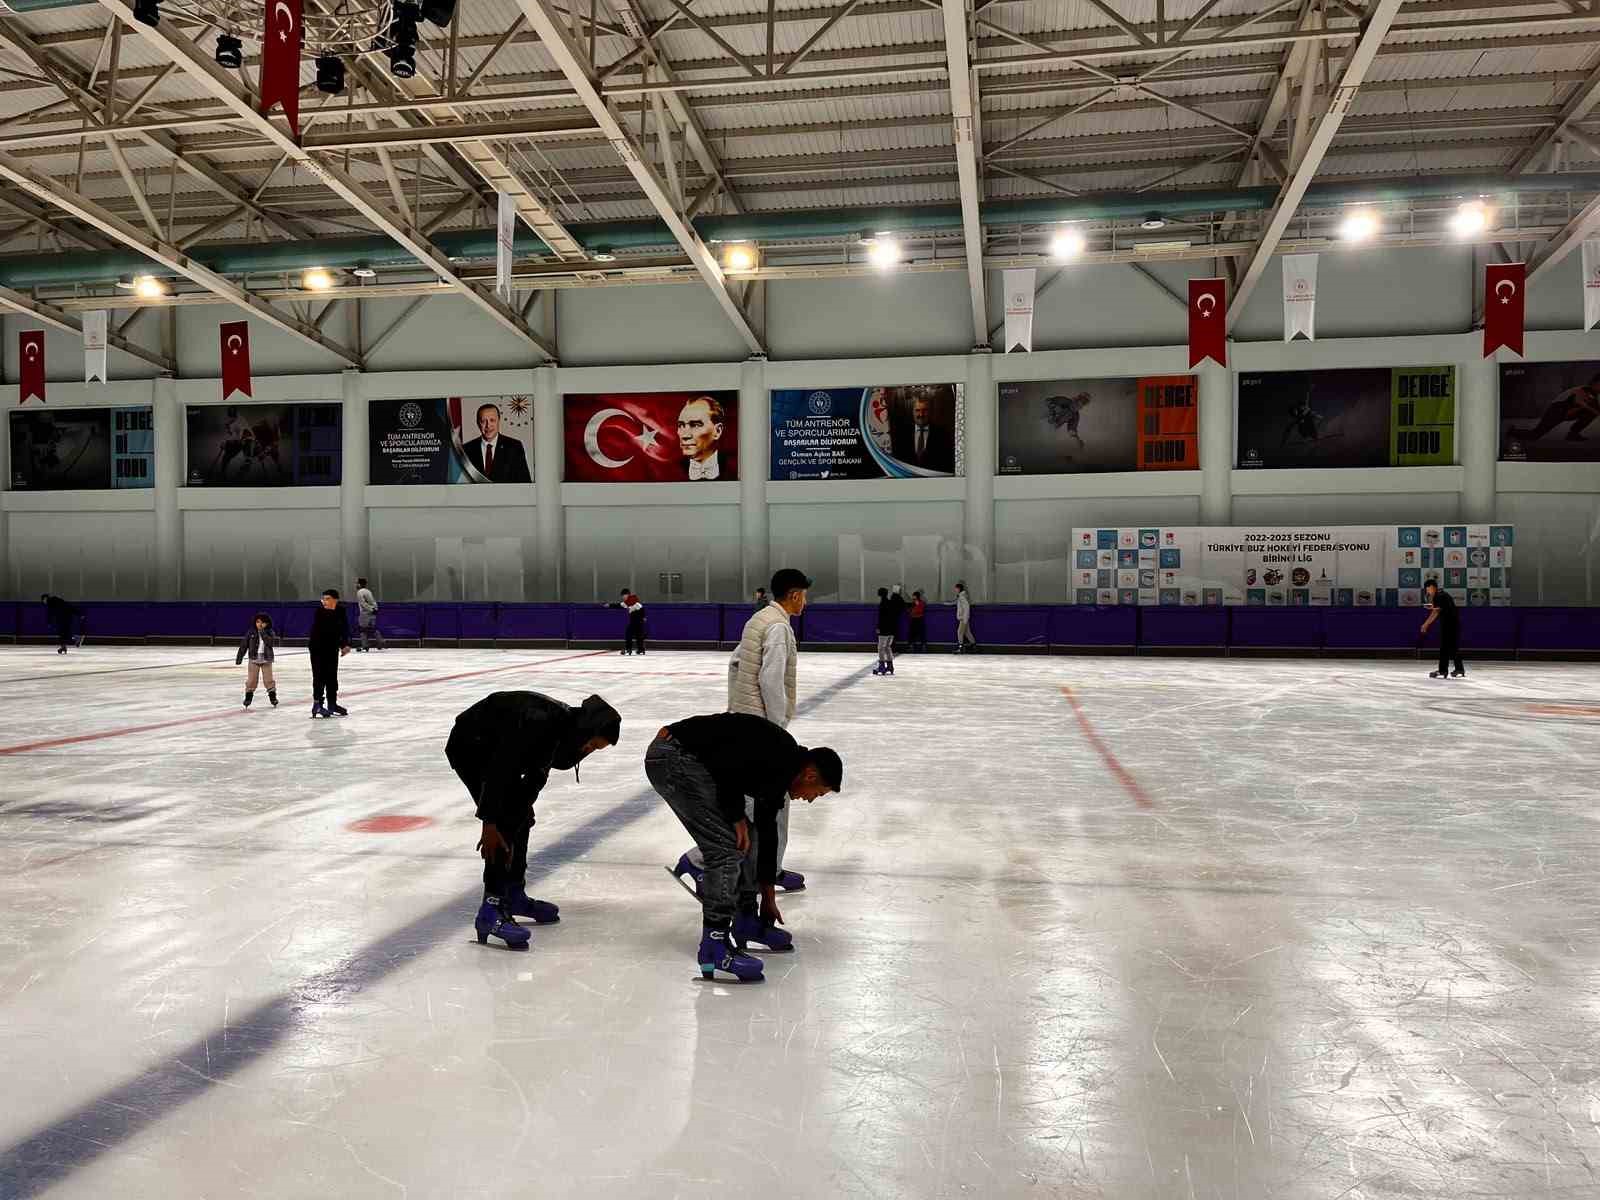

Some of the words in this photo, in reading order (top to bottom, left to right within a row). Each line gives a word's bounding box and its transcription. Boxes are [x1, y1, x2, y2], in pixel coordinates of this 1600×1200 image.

[786, 419, 803, 428] TÜM
[804, 418, 850, 427] ANTRENÖR
[775, 429, 787, 438] VE
[788, 427, 861, 437] SPORCULARIMIZA
[1294, 533, 1330, 541] SEZONU
[1208, 543, 1244, 552] TÜRKİYE
[1247, 544, 1265, 552] BUZ
[1303, 543, 1370, 552] FEDERASYONU
[1298, 553, 1312, 562] LİG
